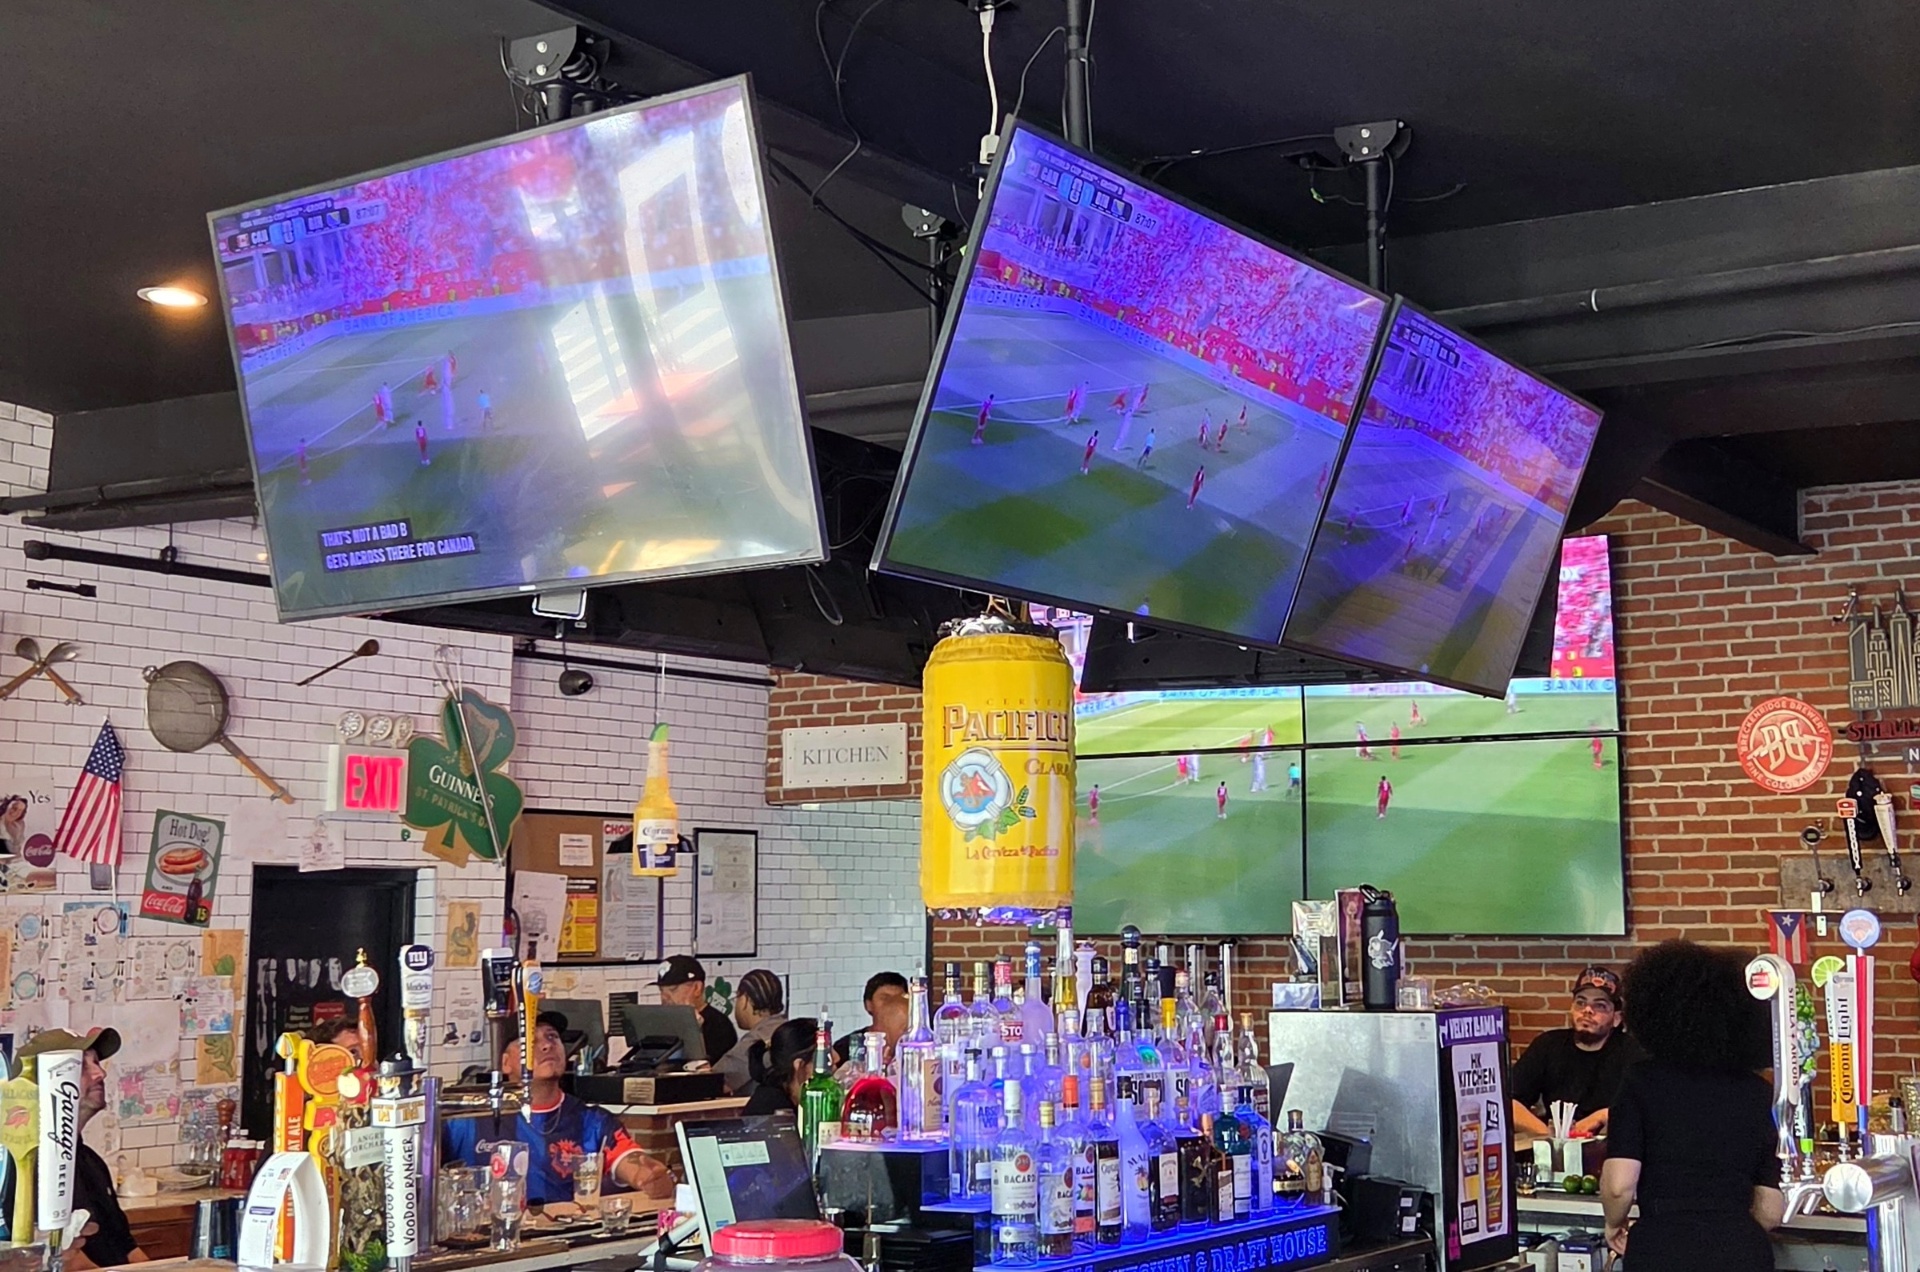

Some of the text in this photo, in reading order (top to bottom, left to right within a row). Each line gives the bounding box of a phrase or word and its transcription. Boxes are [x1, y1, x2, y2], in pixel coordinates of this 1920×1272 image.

[1135, 213, 1157, 231] 87:07
[322, 522, 408, 547] THAT'S NOT A BAD B
[326, 536, 475, 569] GETS ACROSS THERE FOR CANADA
[1740, 702, 1829, 752] BRECKENRIDGE BREWERY
[803, 746, 889, 766] KITCHEN
[1746, 762, 1765, 782] FINE
[29, 790, 50, 804] Yes
[344, 755, 405, 812] EXIT
[429, 764, 495, 809] GUINNES
[169, 819, 187, 838] Hot
[1788, 988, 1796, 1028] STELLA
[1838, 998, 1854, 1104] Corona Light
[1458, 1068, 1496, 1088] KITCHEN
[55, 1081, 80, 1161] Garage
[288, 1115, 301, 1136] ALE
[58, 1164, 67, 1197] BEER
[402, 1136, 415, 1246] VOODOO RANGER
[1211, 1237, 1267, 1272] DRAFT
[1271, 1225, 1327, 1264] HOUSE
